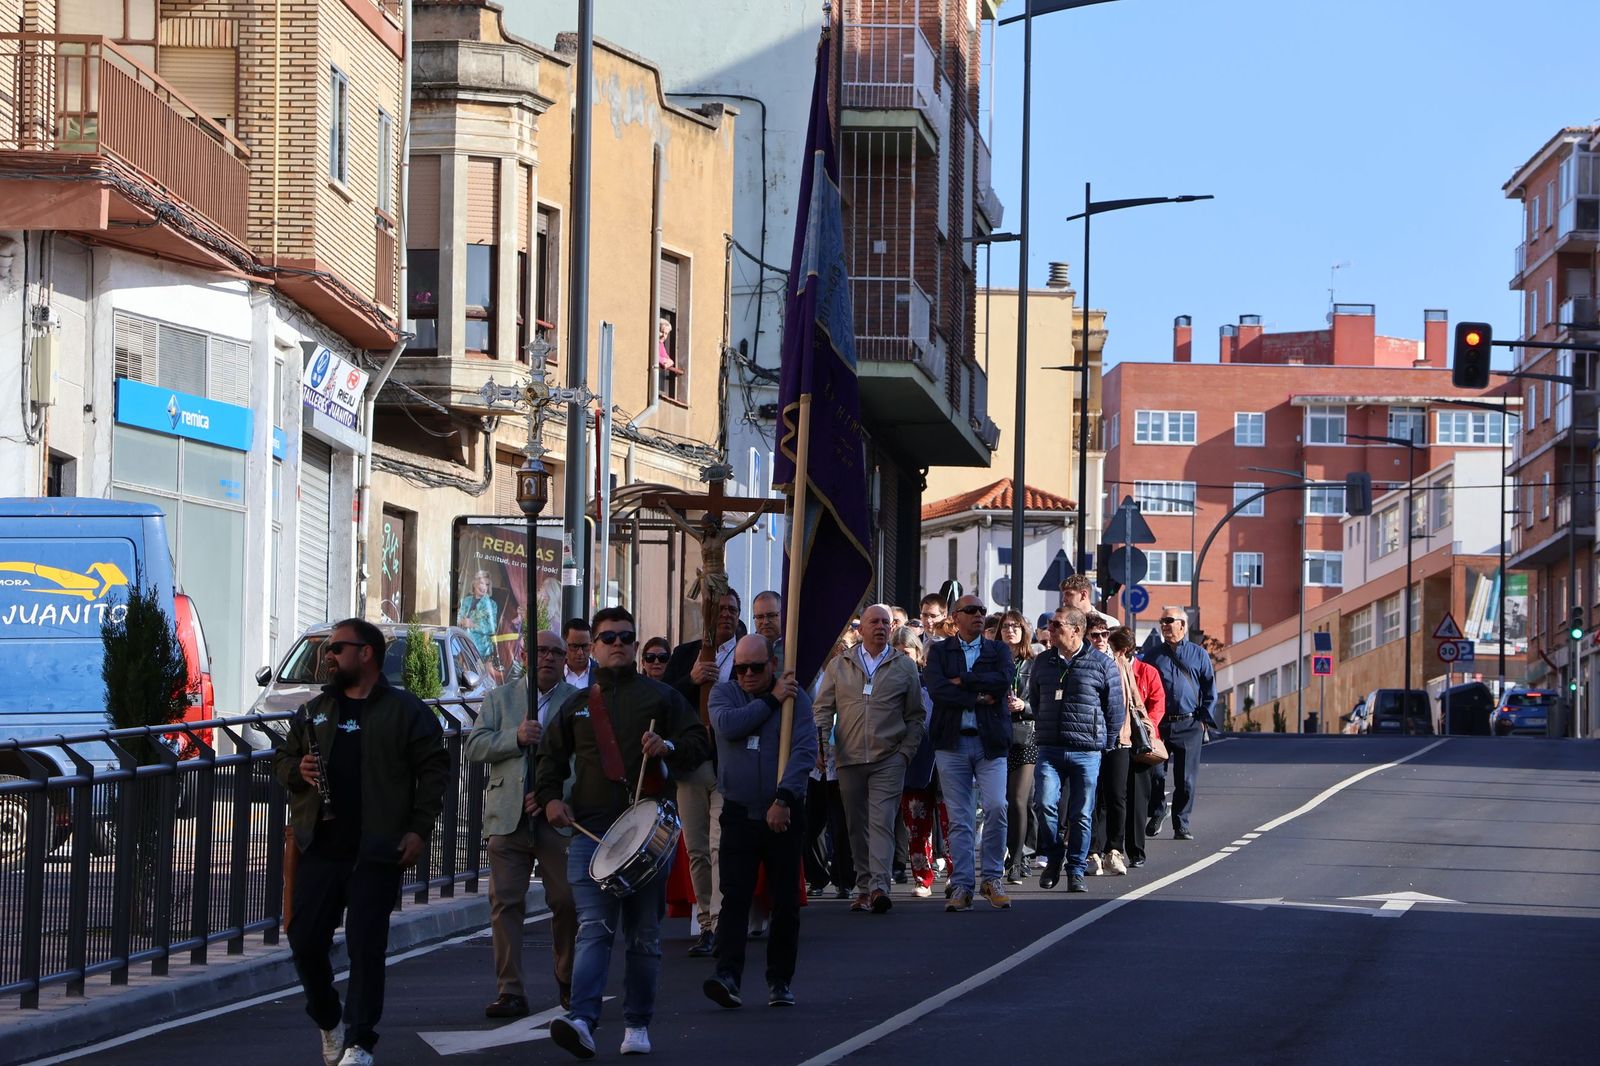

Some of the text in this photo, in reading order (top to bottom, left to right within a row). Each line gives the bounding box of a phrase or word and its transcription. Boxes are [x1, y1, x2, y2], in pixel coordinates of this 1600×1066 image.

[303, 386, 353, 427] TALLERES JUANITO
[336, 388, 356, 407] RIEJU
[182, 410, 209, 429] remica
[482, 536, 555, 562] REBAAS
[484, 554, 511, 566] actitud,
[2, 603, 128, 626] JUANITO
[1441, 647, 1455, 656] 30
